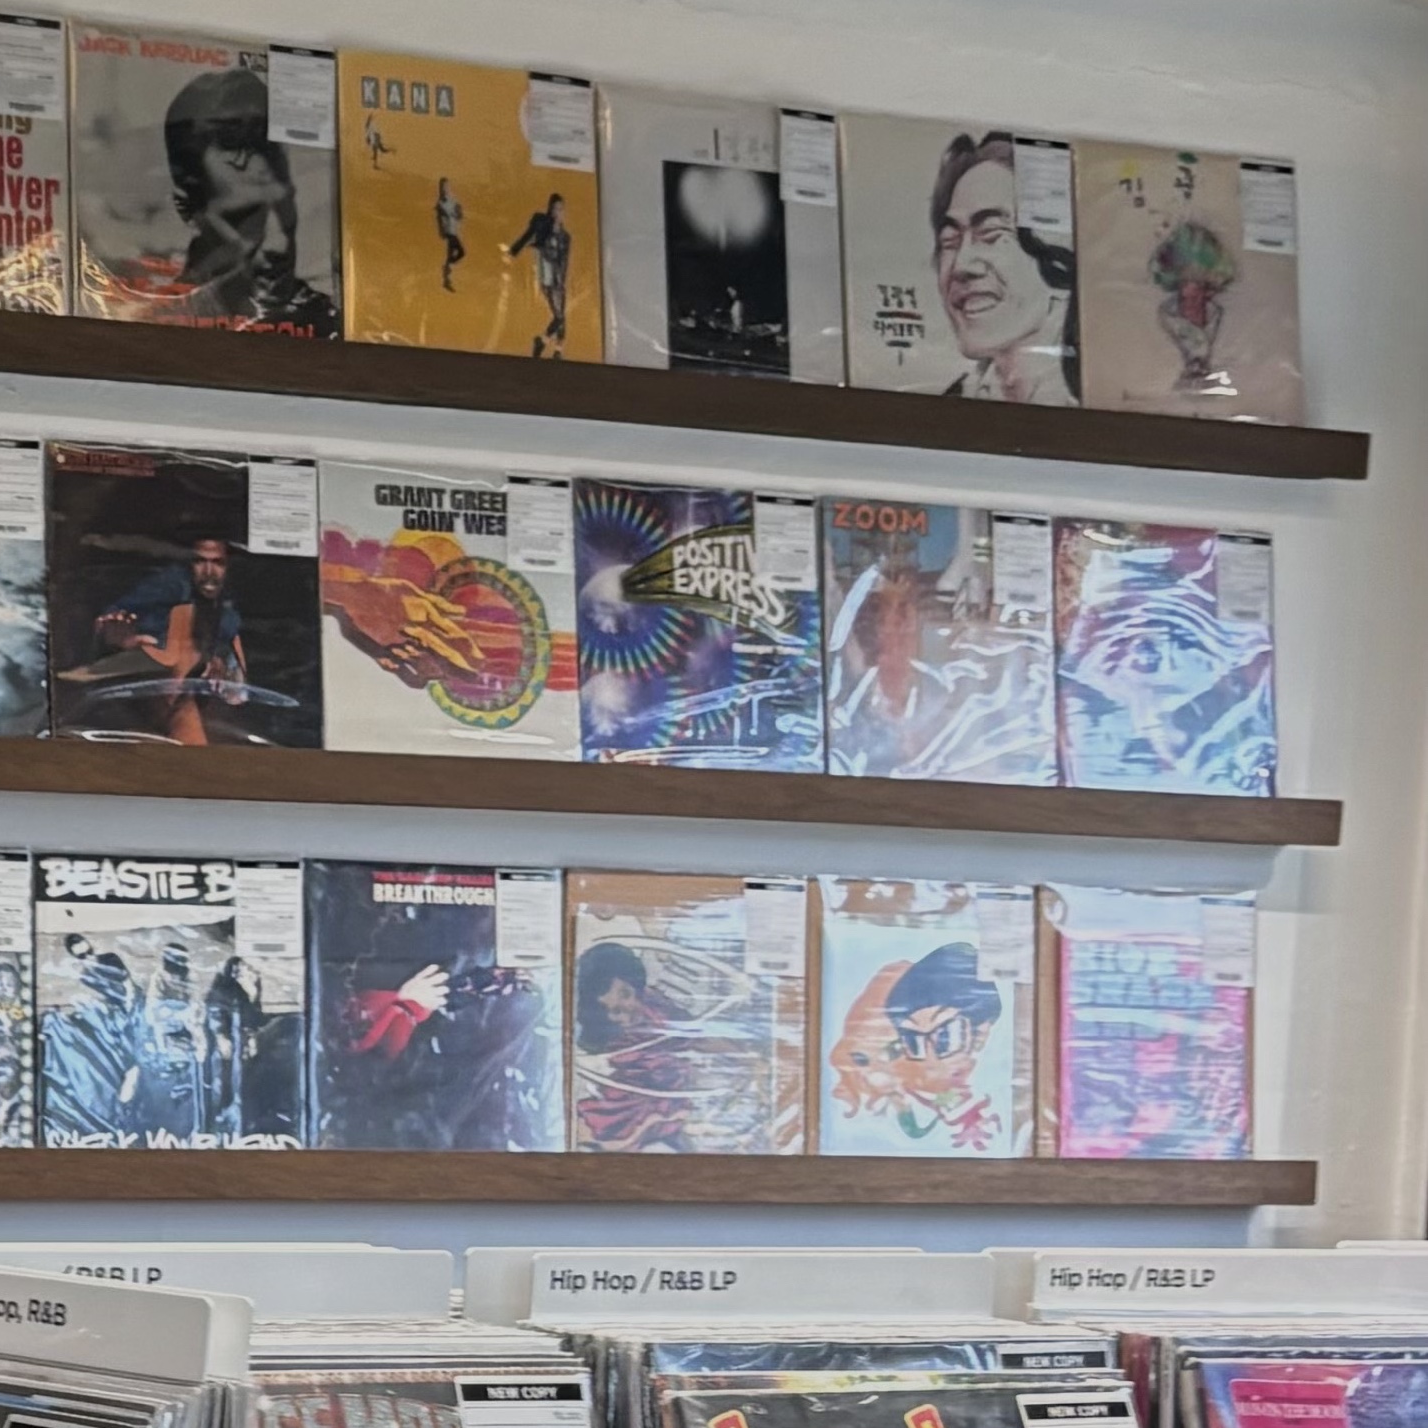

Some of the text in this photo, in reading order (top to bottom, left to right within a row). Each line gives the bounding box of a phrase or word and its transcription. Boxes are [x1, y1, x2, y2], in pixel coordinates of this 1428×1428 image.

[362, 76, 455, 117] KANA
[374, 484, 449, 509] GRANT
[403, 509, 508, 537] GOIN' WES
[832, 502, 929, 537] ZOOM
[672, 534, 760, 575] POSITIV
[673, 566, 786, 627] EXPRESS
[39, 857, 199, 900] BEASTIE
[372, 882, 495, 906] BREAKTHROUGH
[549, 1266, 738, 1294] Hip Hop / R&B LP
[1049, 1265, 1217, 1292] Hip Hop / R&B LP
[27, 1298, 67, 1327] R&B
[486, 1385, 559, 1400] NEW COPY
